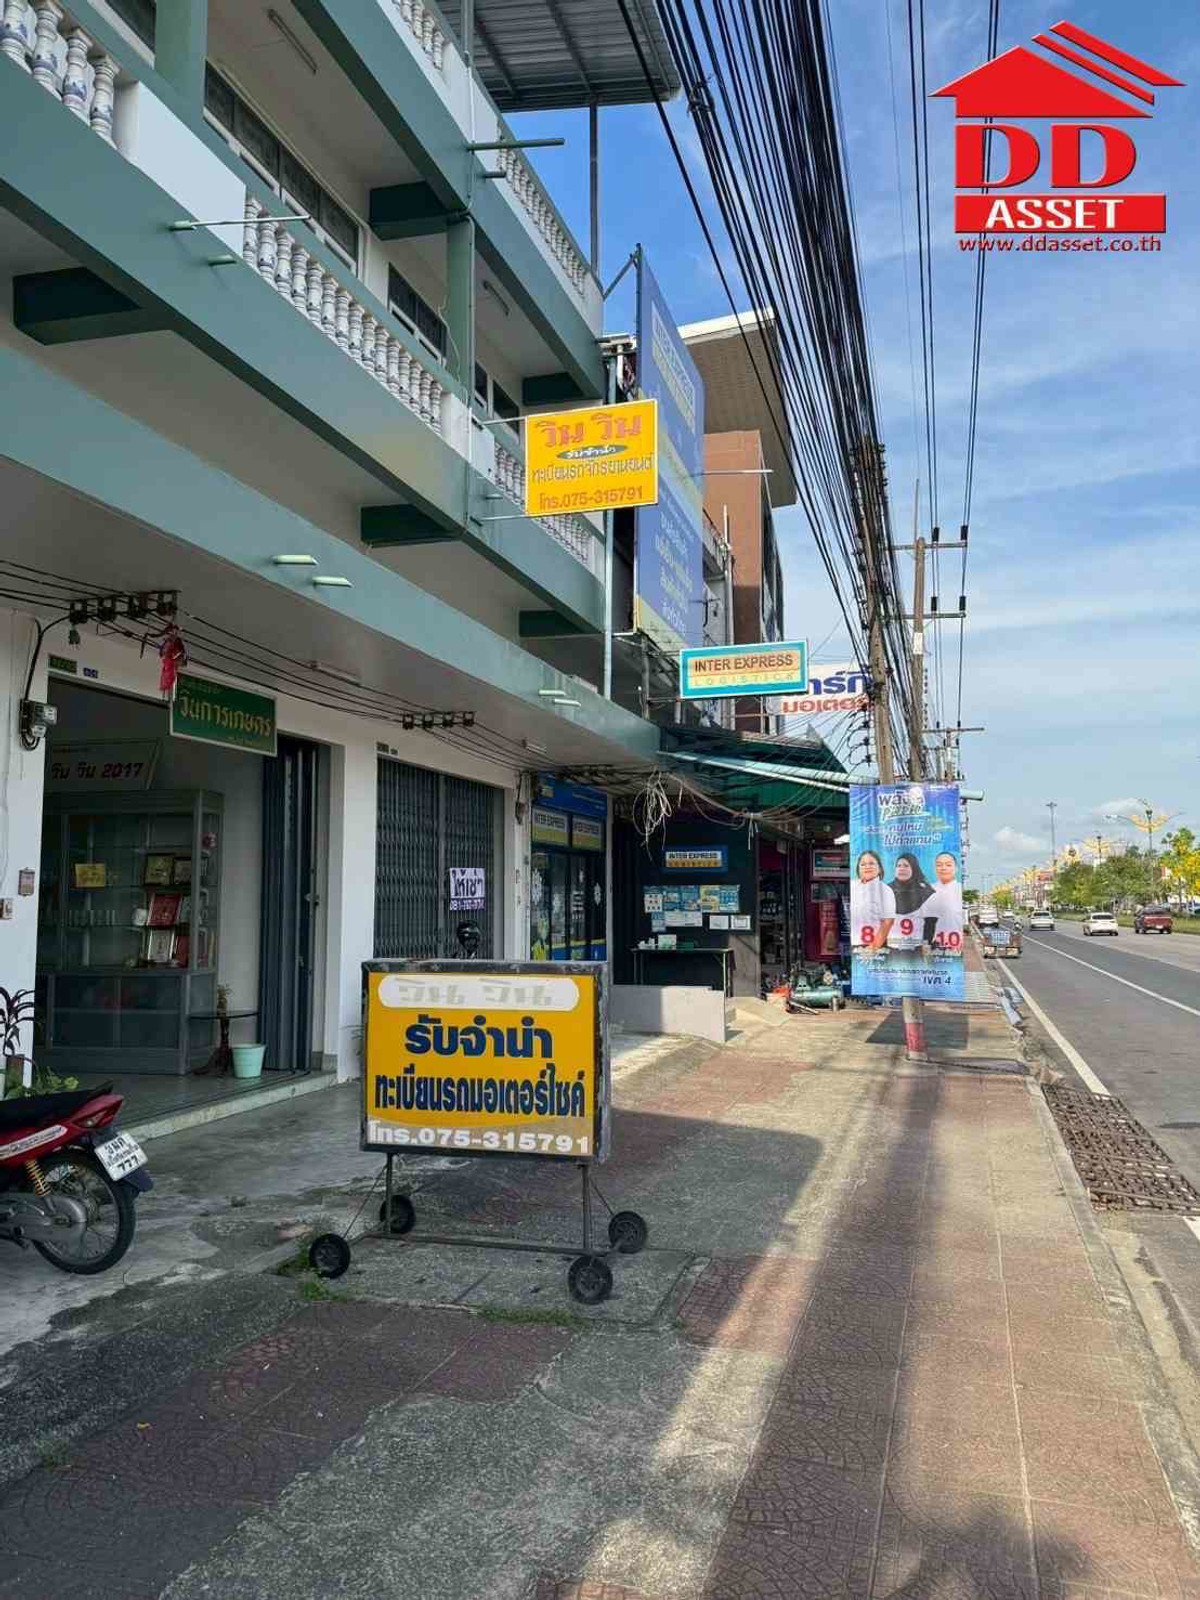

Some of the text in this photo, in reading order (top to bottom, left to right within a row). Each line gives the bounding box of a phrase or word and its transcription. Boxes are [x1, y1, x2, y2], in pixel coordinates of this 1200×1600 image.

[694, 653, 794, 673] INTER EXPRESS
[101, 762, 144, 779] 2017
[451, 869, 483, 897] ให้เช่า
[861, 925, 875, 943] 8
[900, 918, 914, 935] 9
[936, 931, 961, 947] 10
[944, 975, 953, 985] 4
[405, 1013, 554, 1059] รับจำนำ
[367, 1118, 590, 1154] โทร.075-315791
[117, 1154, 140, 1172] 777
